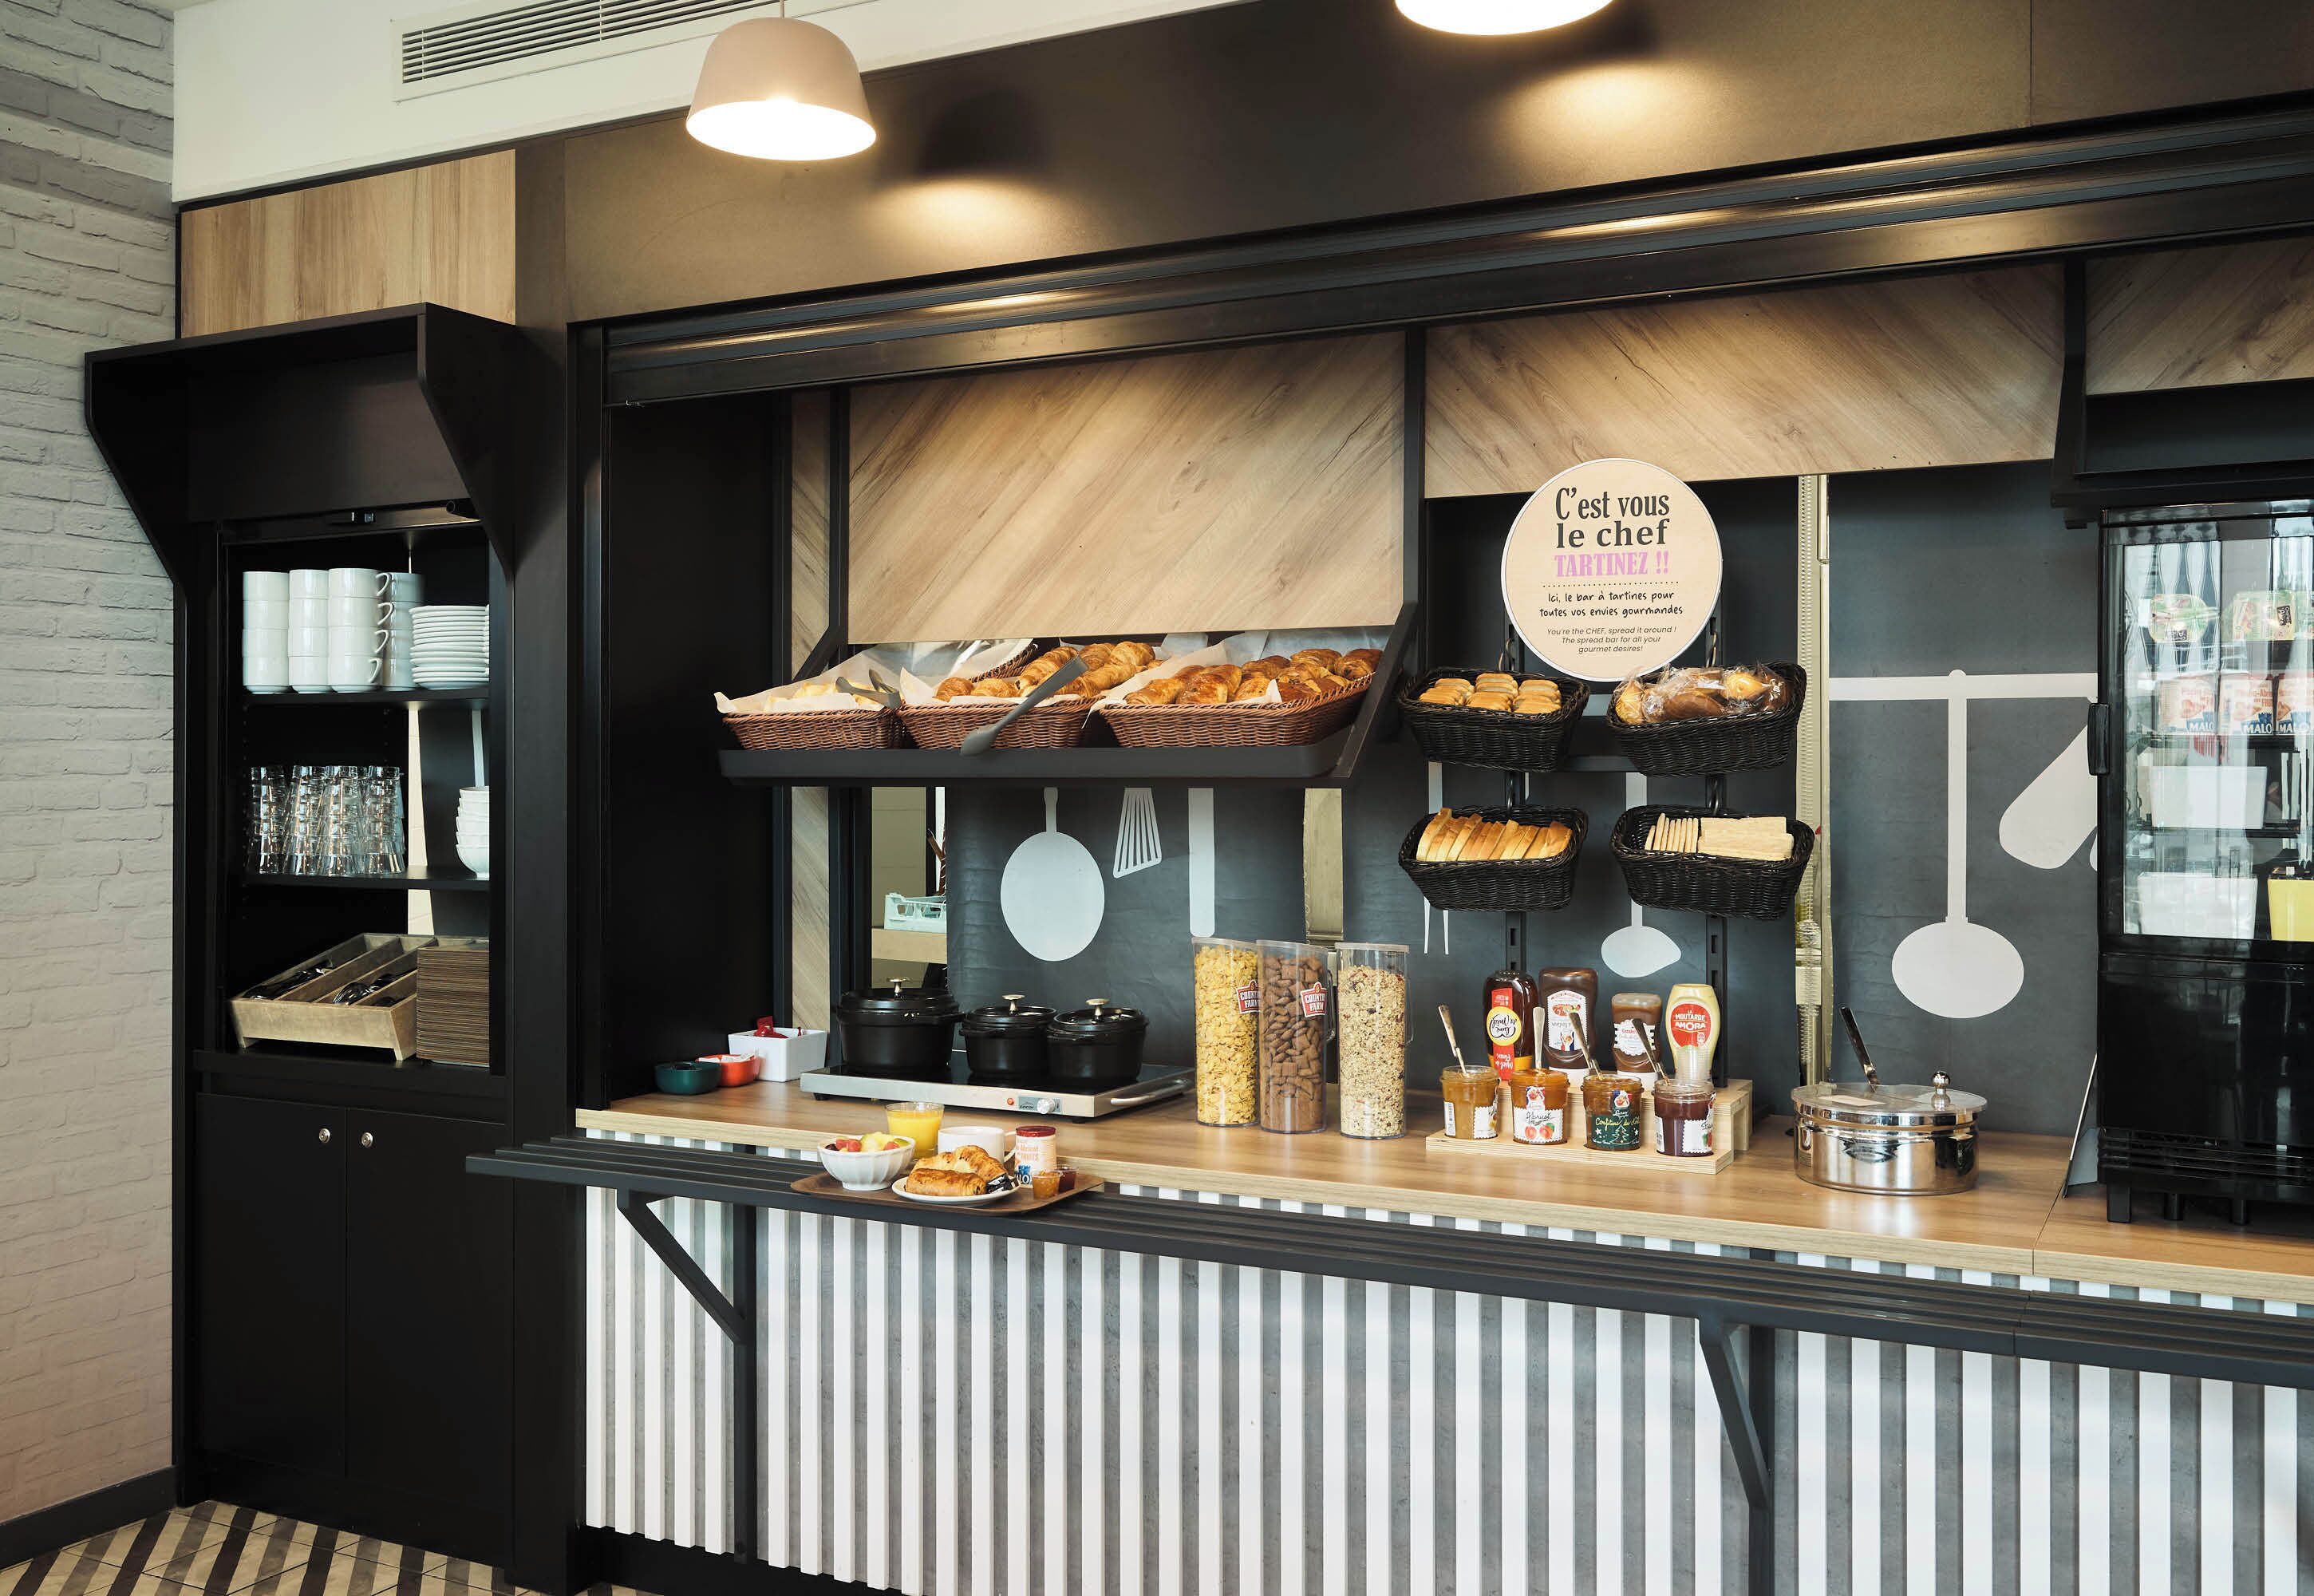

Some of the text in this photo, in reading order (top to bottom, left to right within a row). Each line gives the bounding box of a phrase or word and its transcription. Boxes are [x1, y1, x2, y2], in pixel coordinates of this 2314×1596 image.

[1556, 488, 1670, 519] C'est vous
[1557, 519, 1670, 548] le chef
[1554, 551, 1669, 577] TARTINEZ !!
[1548, 594, 1561, 602] Ici,
[1565, 593, 1572, 602] le
[1598, 591, 1605, 600] à
[1609, 591, 1647, 601] tartines
[1651, 592, 1674, 602] pour
[1539, 608, 1567, 617] toutes
[1590, 606, 1618, 616] envies
[1622, 605, 1683, 618] gourmandes
[1578, 646, 1611, 654] gourmet
[2243, 723, 2273, 733] MALO
[2279, 724, 2310, 733] MALO
[1309, 1002, 1324, 1011] FARM
[1675, 1021, 1706, 1031] AMORA
